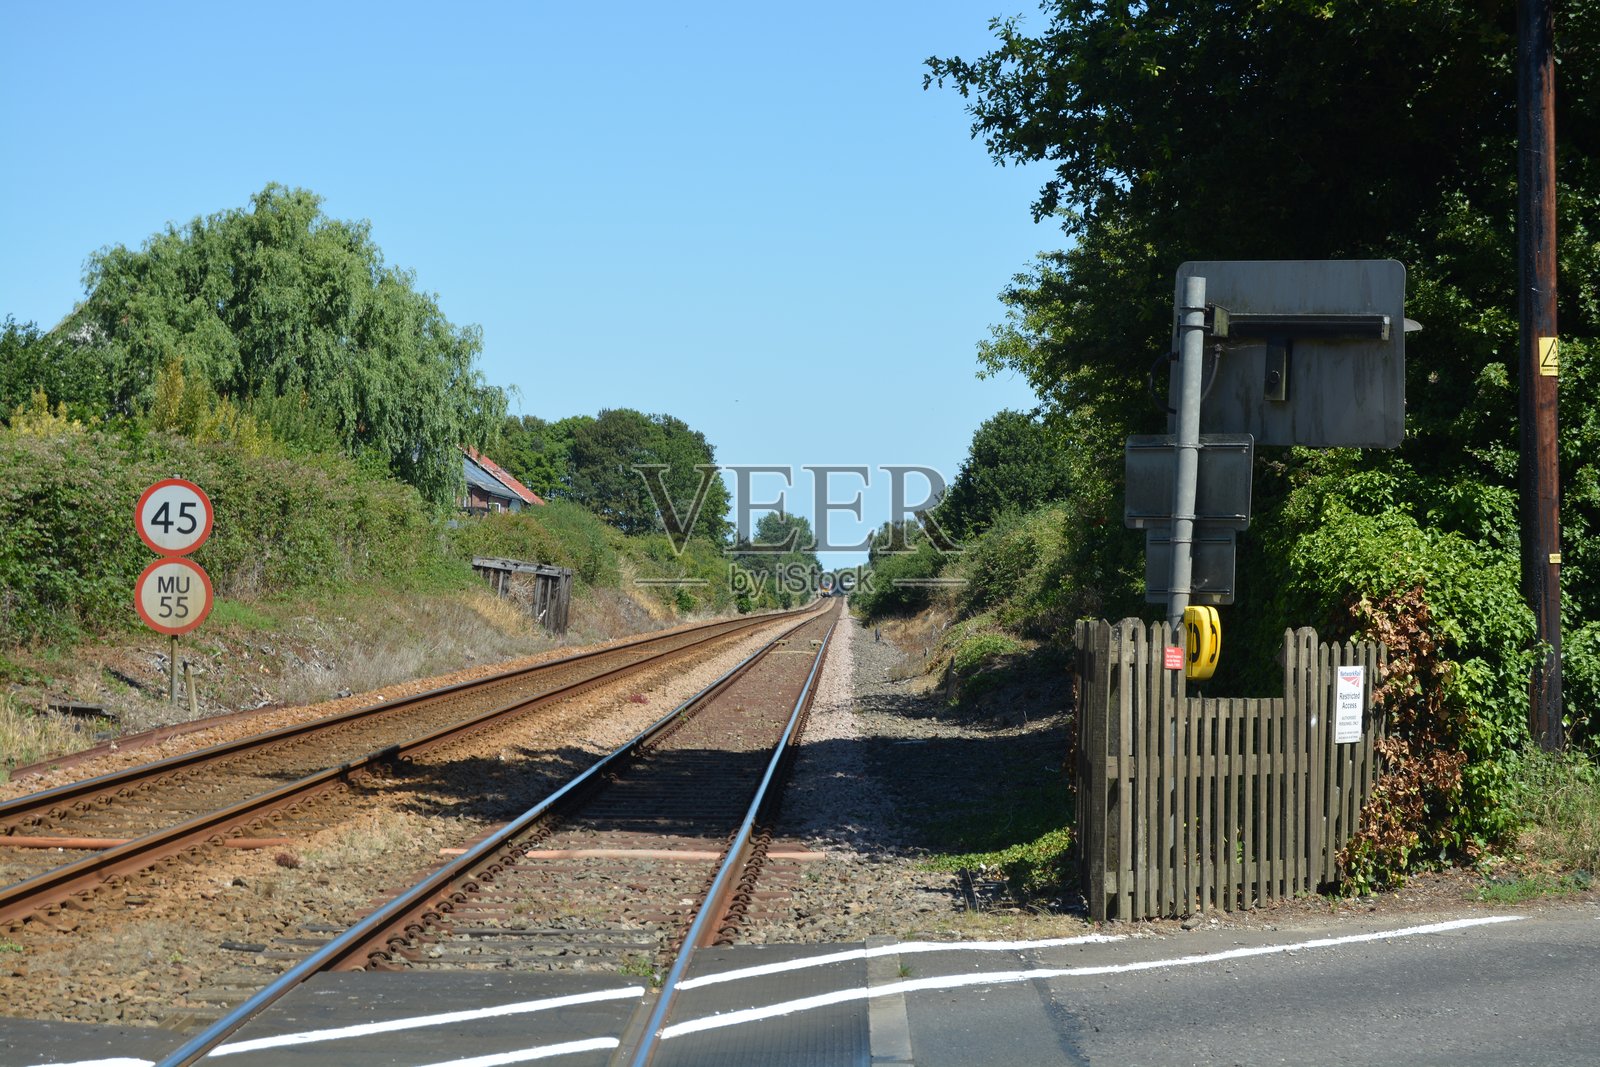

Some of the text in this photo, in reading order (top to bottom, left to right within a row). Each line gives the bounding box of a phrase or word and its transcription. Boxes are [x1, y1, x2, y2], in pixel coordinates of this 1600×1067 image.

[150, 501, 197, 534] 45
[157, 576, 190, 594] MU
[158, 596, 189, 618] 55
